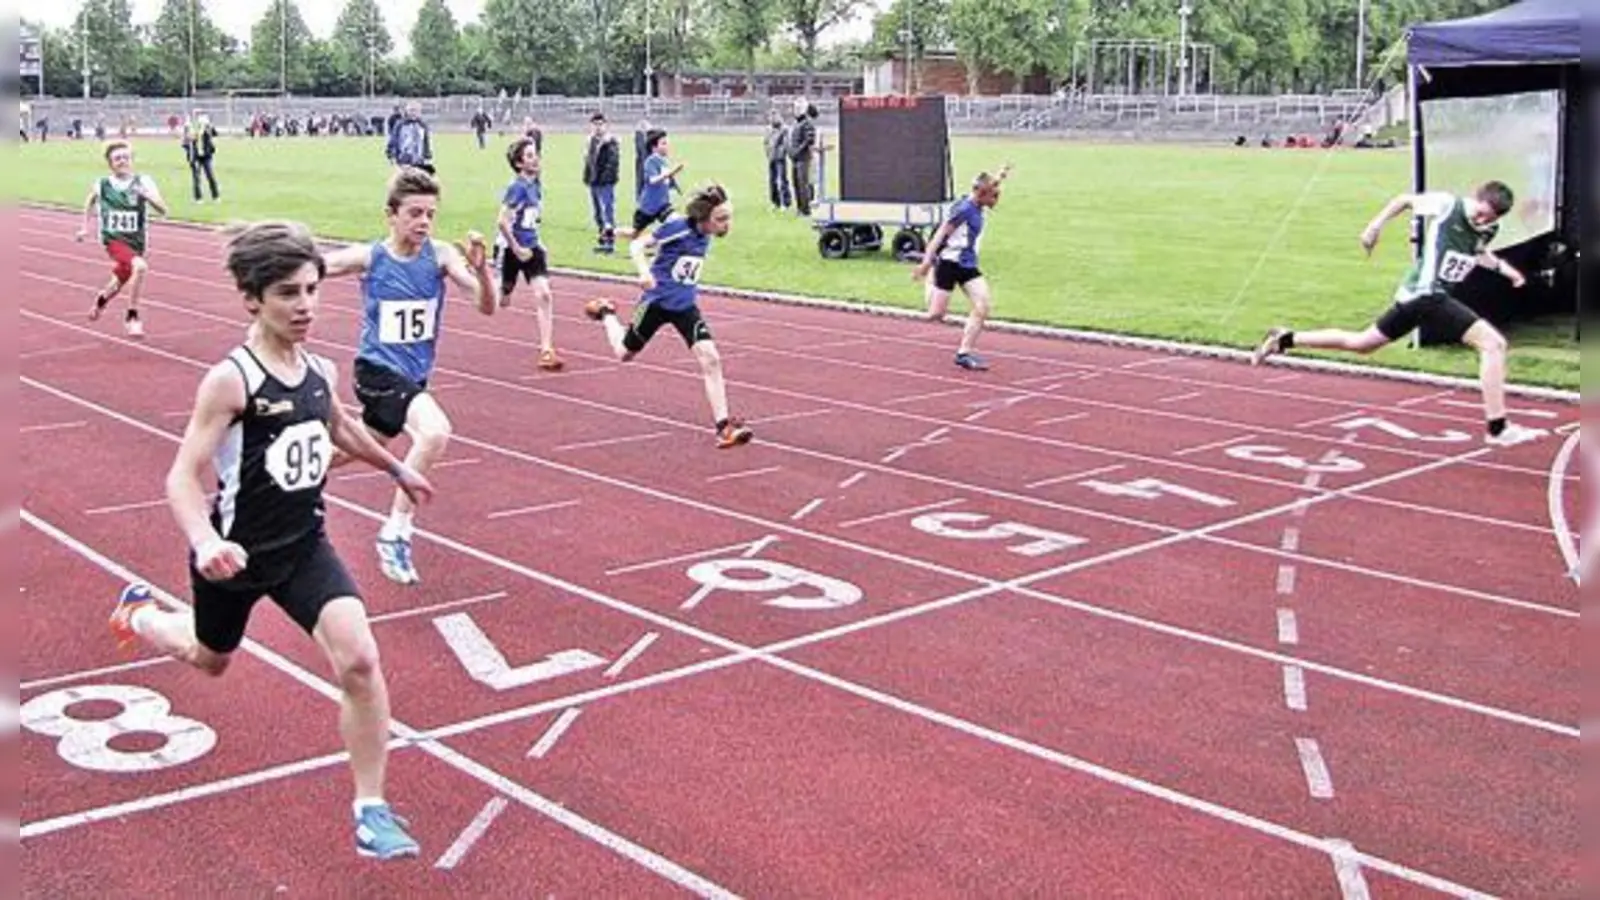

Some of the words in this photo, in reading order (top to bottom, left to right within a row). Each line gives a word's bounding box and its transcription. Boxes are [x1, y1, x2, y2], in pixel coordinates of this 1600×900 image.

[394, 308, 425, 340] 15
[1331, 416, 1472, 442] 2
[284, 433, 321, 486] 95
[1225, 445, 1366, 473] 3
[1081, 477, 1238, 508] 4
[910, 512, 1090, 557] 5
[686, 558, 863, 610] 6
[432, 612, 606, 690] 7
[20, 684, 217, 772] 8
